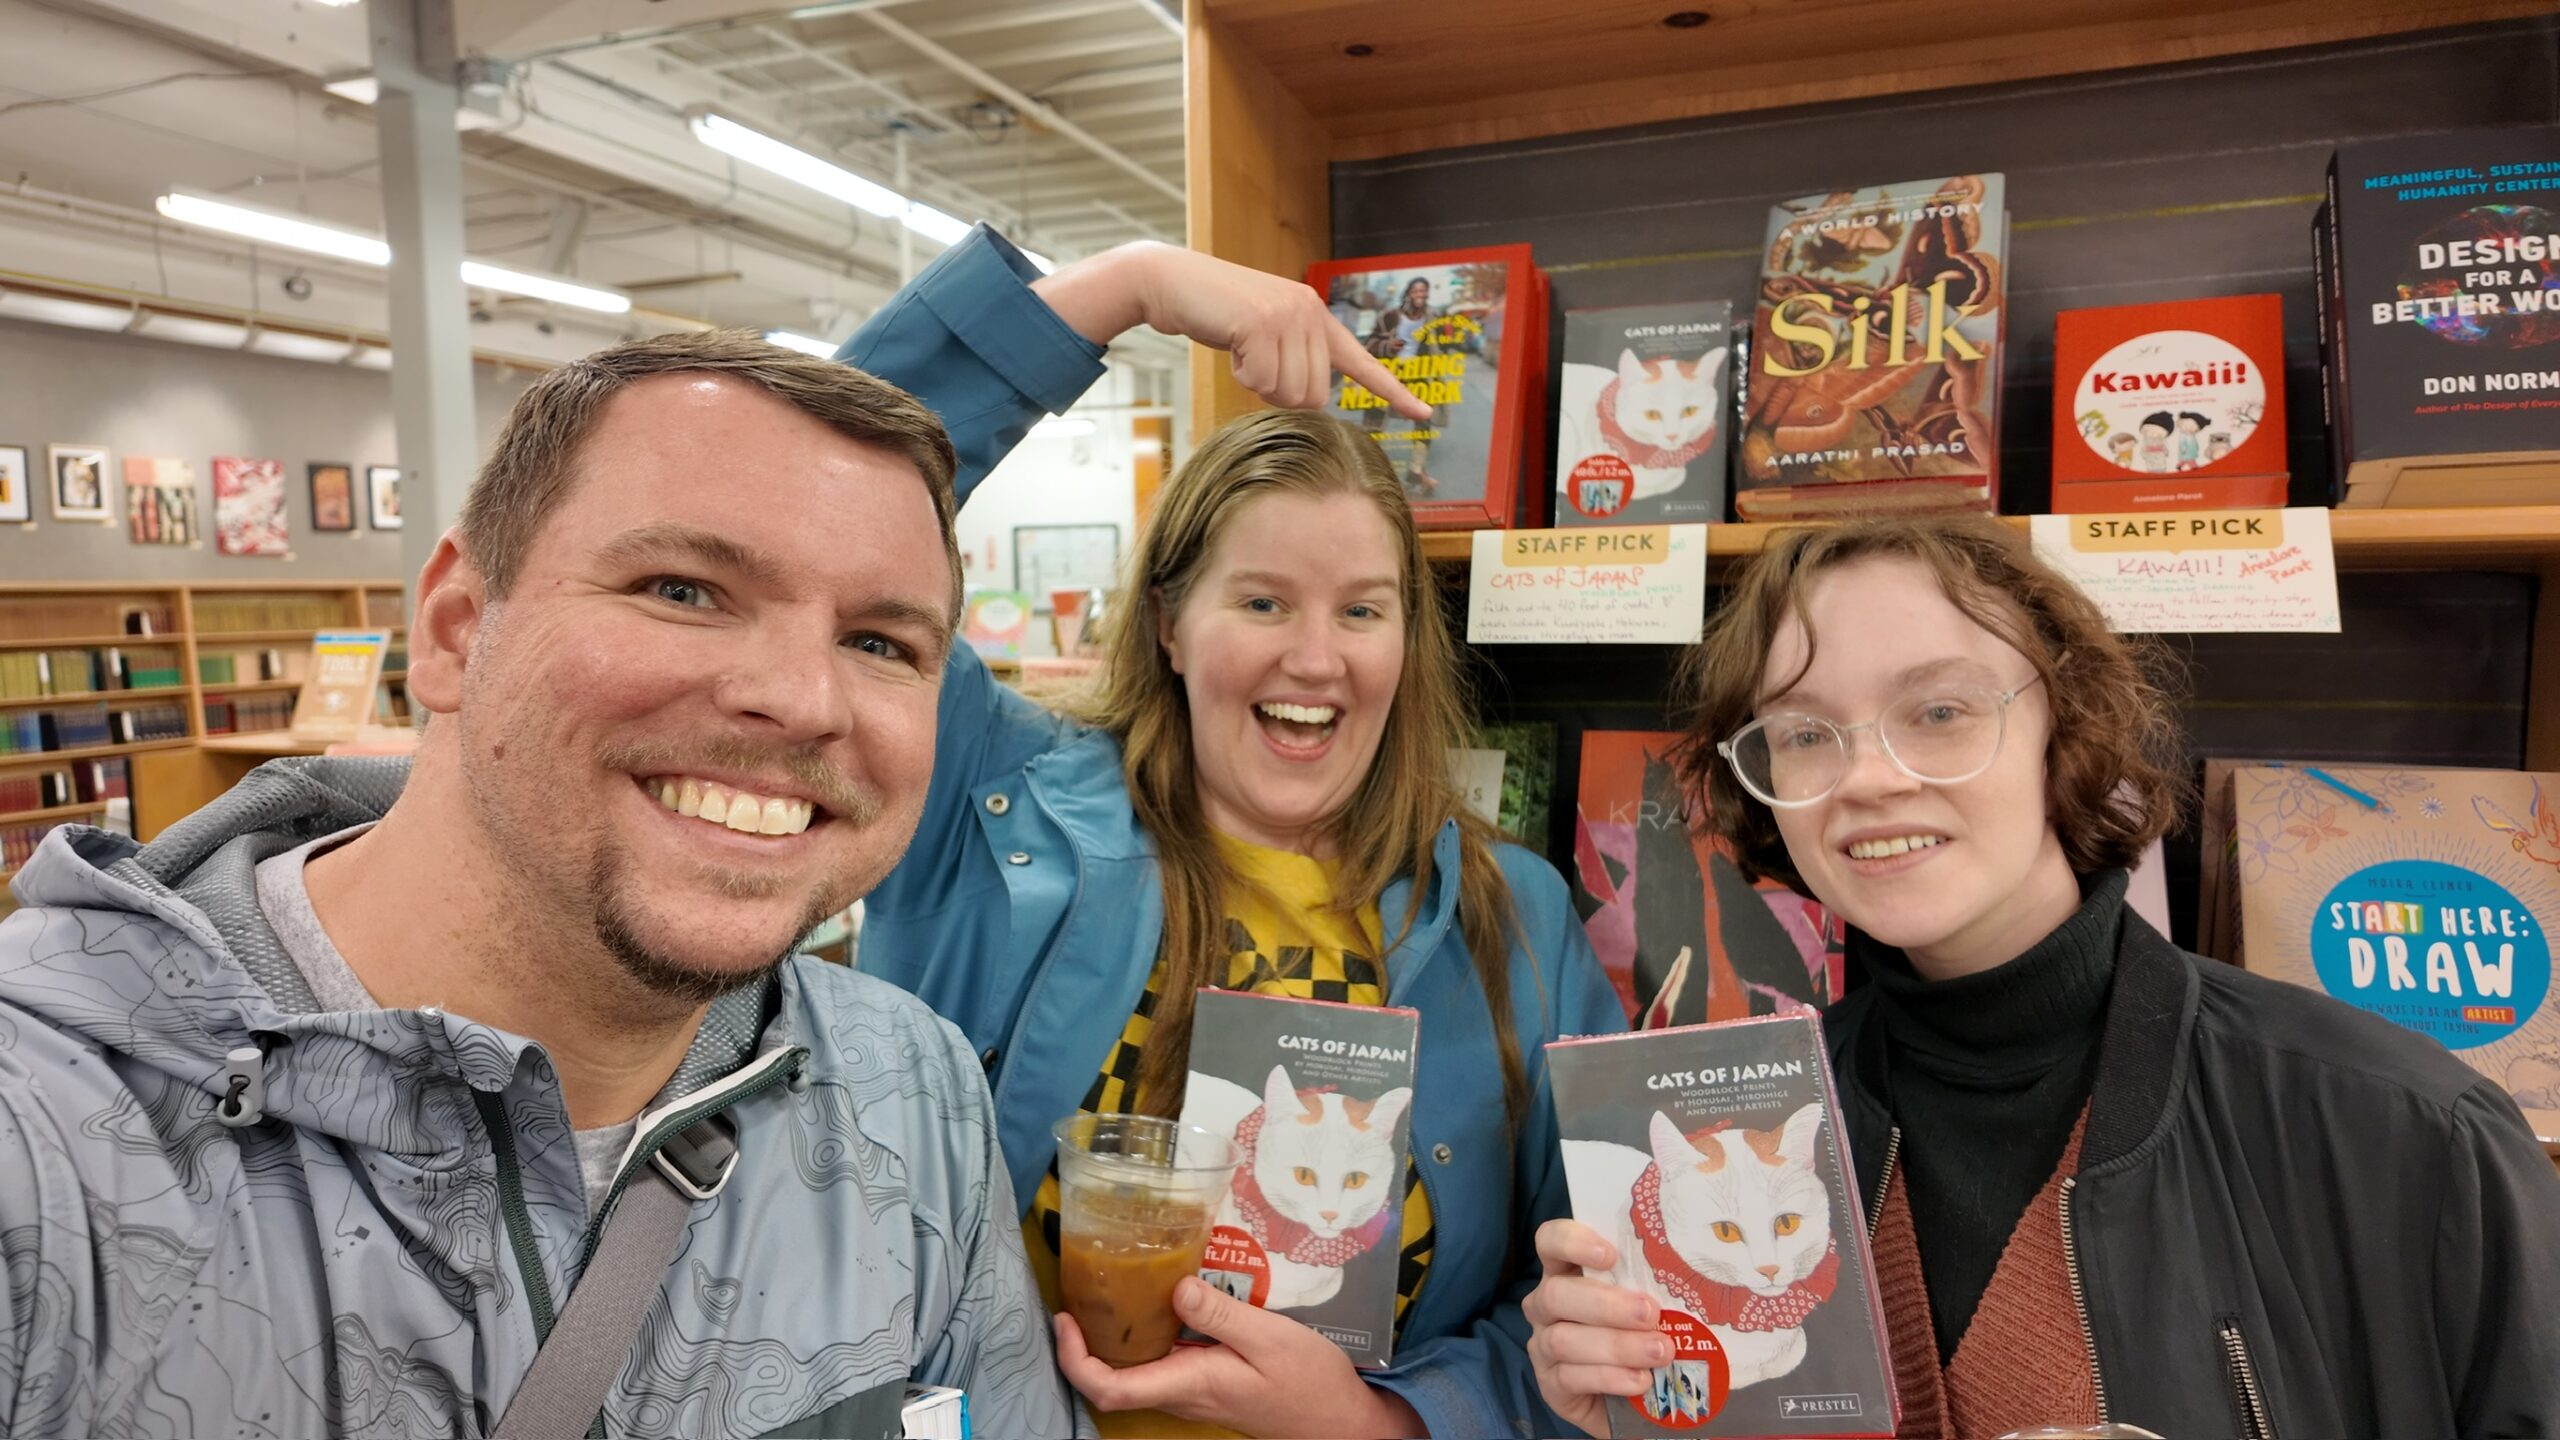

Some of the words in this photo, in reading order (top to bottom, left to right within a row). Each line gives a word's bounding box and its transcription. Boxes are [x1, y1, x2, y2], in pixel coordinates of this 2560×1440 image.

[2364, 168, 2484, 190] MEANINGFUL,
[2490, 162, 2560, 177] SUSTAIN
[2398, 183, 2488, 200] HUMANITY
[2495, 178, 2560, 192] CENTER
[1781, 228, 1793, 240] A
[1802, 215, 1879, 235] WORLD
[1887, 203, 1985, 224] HISTORY
[2466, 270, 2512, 287] FOR
[2519, 269, 2537, 284] A
[2372, 293, 2500, 325] BETTER
[2511, 289, 2560, 312] WO
[1624, 326, 1656, 338] CATS
[1657, 324, 1675, 336] OF
[1677, 322, 1722, 335] JAPAN
[1763, 280, 1985, 377] Silk
[2092, 362, 2247, 395] Kawaii!
[2424, 375, 2475, 395] DON
[2485, 371, 2560, 392] NORM
[2415, 403, 2448, 414] Author
[2450, 403, 2461, 412] of
[2463, 402, 2481, 411] The
[2483, 401, 2517, 412] Design
[2519, 400, 2530, 410] of
[1765, 450, 1859, 467] AARATHI
[1872, 441, 1966, 459] PRASAD
[2089, 520, 2176, 538] STAFF
[2191, 518, 2263, 536] PICK
[1517, 536, 1587, 554] STAFF
[1597, 533, 1653, 551] PICK
[1490, 572, 1536, 592] CATS
[1569, 566, 1645, 592] JAPAN
[2368, 878, 2413, 890] MOIRA
[2330, 901, 2422, 932] START
[2441, 905, 2530, 938] HERE:
[2348, 936, 2515, 998] DRAW
[2376, 1002, 2406, 1016] WAYS
[2411, 1004, 2424, 1016] TO
[2429, 1006, 2440, 1018] BE
[2444, 1008, 2458, 1019] AN
[2466, 1009, 2507, 1022] ARTIST
[2443, 1021, 2480, 1034] TRYING
[1278, 1034, 1320, 1051] CATS
[1322, 1039, 1347, 1055] OF
[1348, 1043, 1407, 1062] JAPAN
[1646, 1070, 1696, 1090] CATS
[1699, 1067, 1728, 1085] OF
[1732, 1060, 1803, 1084] JAPAN
[1674, 1101, 1684, 1109] BY
[1687, 1096, 1733, 1107] HOKUSAI,
[1736, 1090, 1789, 1101] HIROSHIGE
[1681, 1086, 1740, 1098] WOODBLOCK
[1743, 1082, 1777, 1092] PRINTS
[1686, 1108, 1707, 1117] AND
[1709, 1105, 1742, 1115] OTHER
[1744, 1101, 1782, 1111] ARTISTS
[1674, 1321, 1693, 1332] out
[1674, 1335, 1695, 1351] 12
[1696, 1338, 1718, 1351] m.
[1802, 1399, 1856, 1414] PRESTEL
